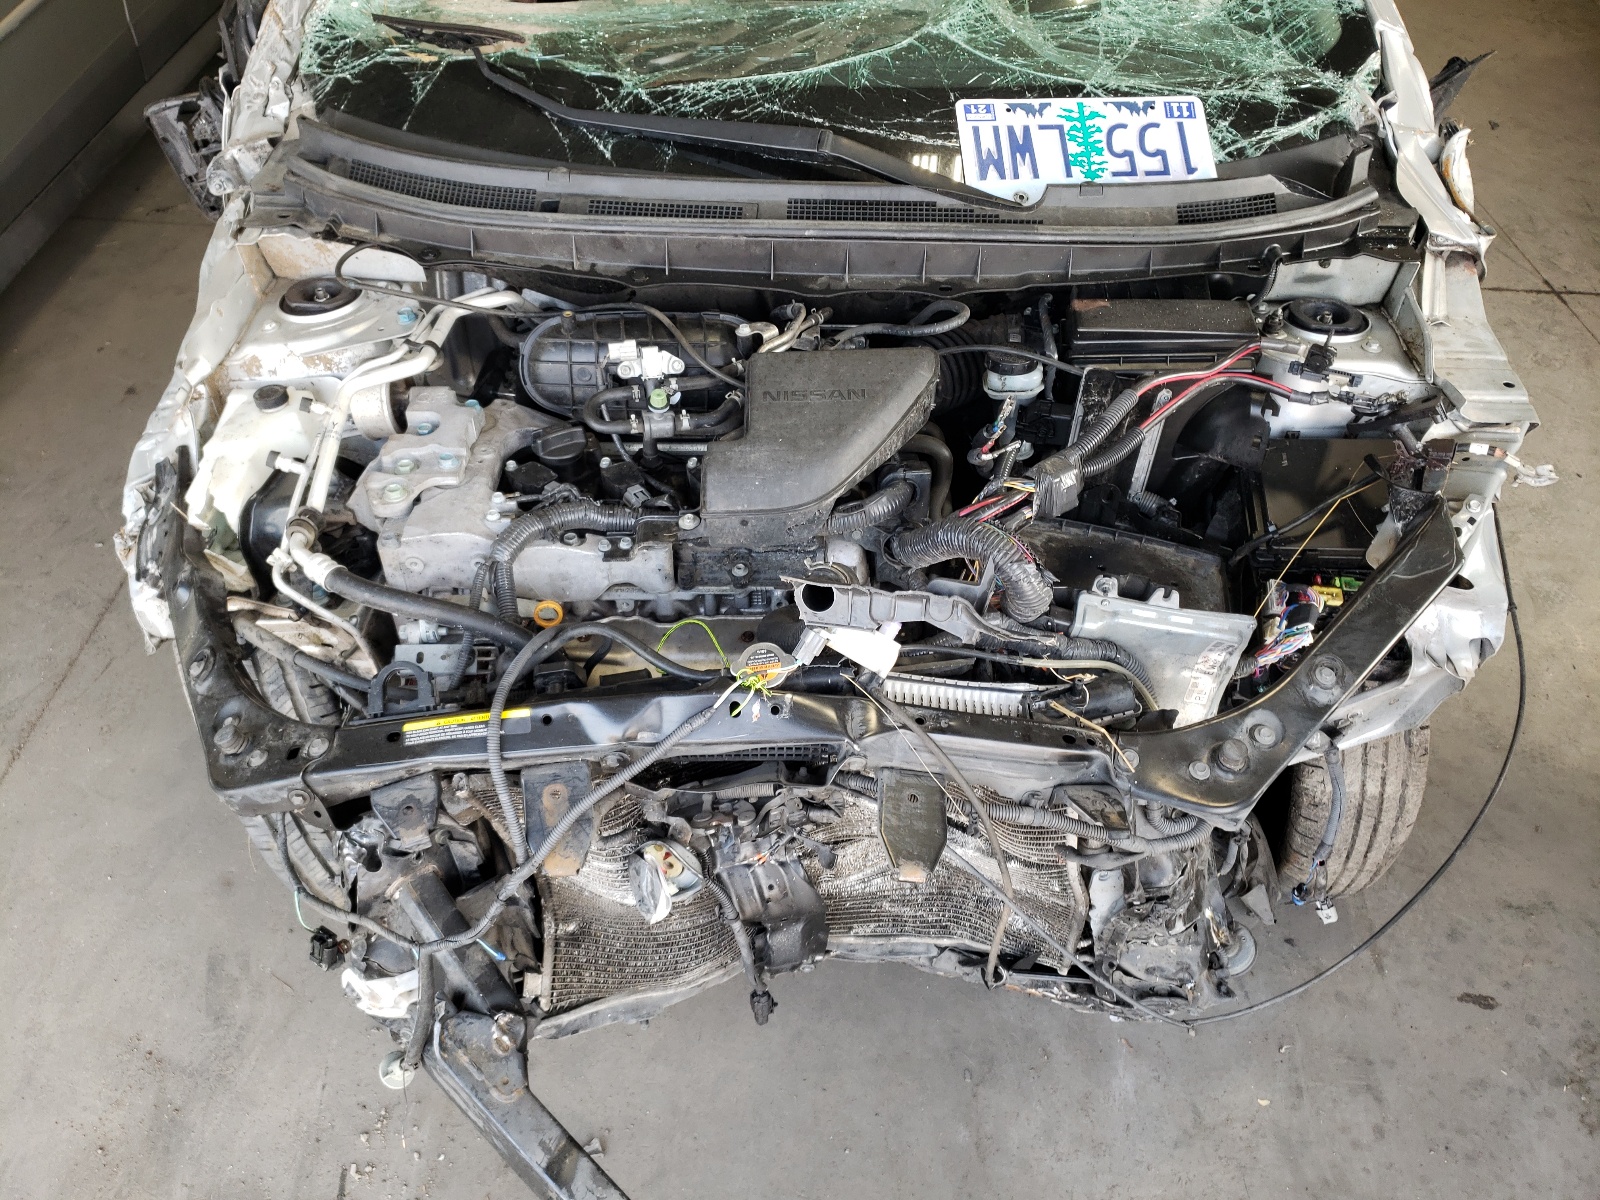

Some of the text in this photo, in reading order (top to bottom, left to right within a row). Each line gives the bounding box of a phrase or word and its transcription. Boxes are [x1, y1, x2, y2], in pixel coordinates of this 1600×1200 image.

[970, 104, 987, 114] 21
[1170, 103, 1190, 118] 11
[972, 121, 1198, 180] 155 LWM
[762, 388, 866, 402] NISSAN
